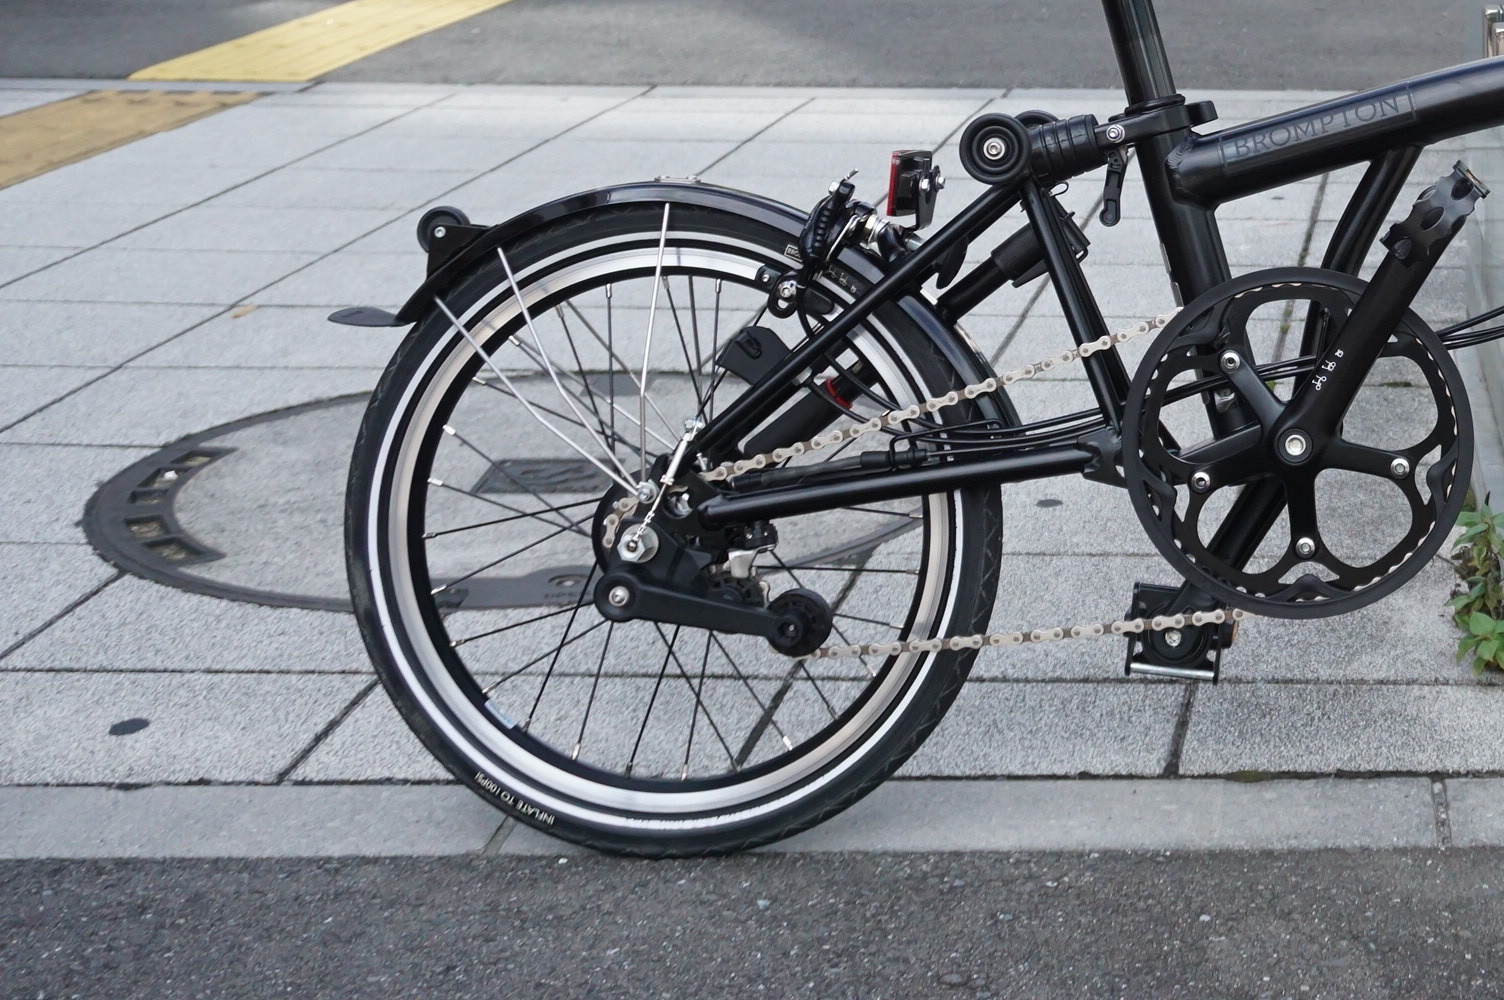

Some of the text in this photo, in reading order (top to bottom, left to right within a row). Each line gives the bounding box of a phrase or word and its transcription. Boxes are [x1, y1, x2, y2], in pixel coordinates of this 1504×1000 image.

[1233, 96, 1402, 159] BROMPTON
[474, 771, 555, 826] INFLATE TO 100PSI
